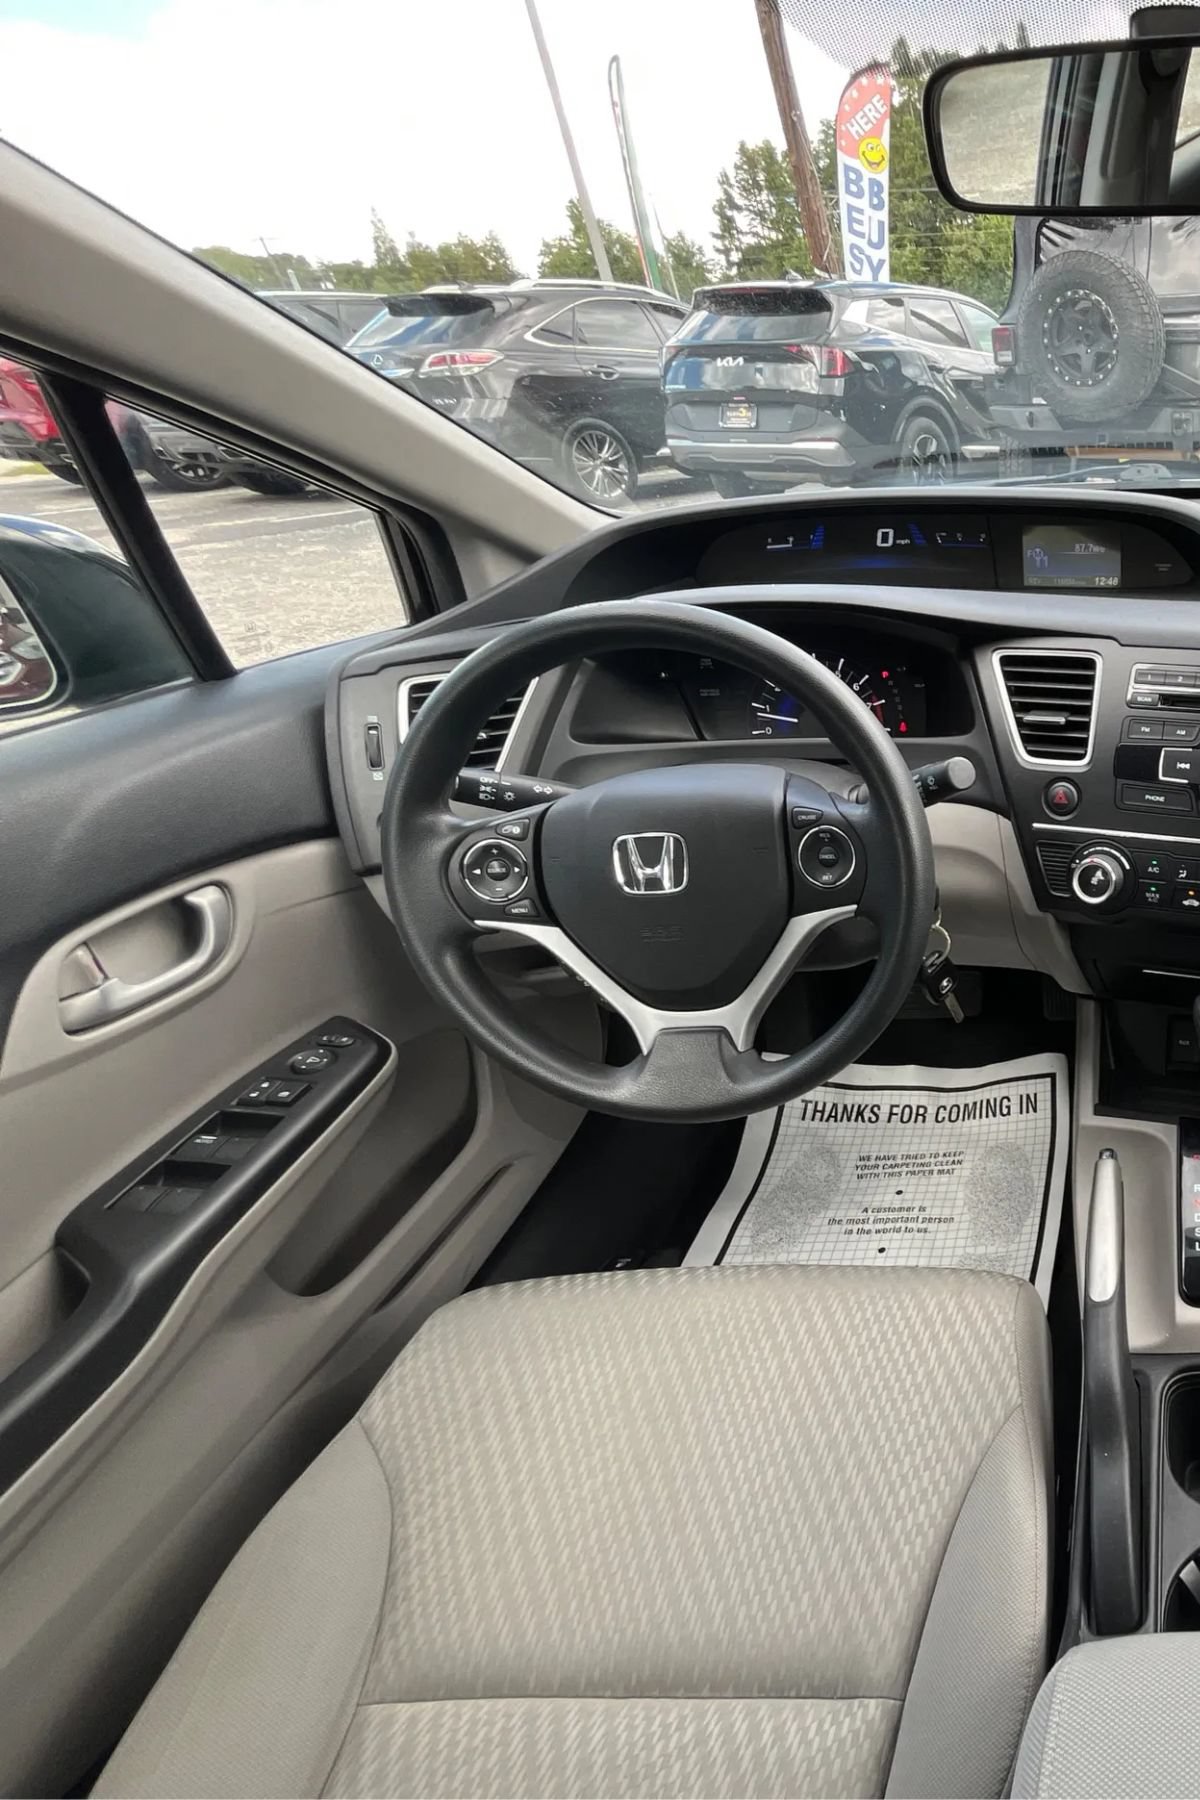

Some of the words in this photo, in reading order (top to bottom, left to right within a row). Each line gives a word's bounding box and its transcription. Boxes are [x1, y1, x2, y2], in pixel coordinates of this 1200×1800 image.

[847, 94, 888, 140] HERE
[866, 177, 886, 282] BUY
[876, 528, 894, 548] 0
[895, 538, 911, 546] mph
[853, 683, 860, 691] 6
[765, 727, 772, 736] 0
[1144, 794, 1165, 802] PHONE
[800, 1098, 881, 1124] THANKS
[887, 1103, 928, 1124] FOR
[934, 1095, 1011, 1123] COMING
[1019, 1092, 1038, 1115] IN
[858, 1154, 873, 1162] WE
[875, 1153, 898, 1162] HAVE
[900, 1152, 926, 1161] TRIED
[929, 1152, 940, 1160] TO
[942, 1150, 965, 1158] KEEP
[855, 1163, 880, 1172] YOUR
[882, 1160, 932, 1171] CARPETING
[934, 1159, 963, 1167] CLEAN
[856, 1172, 881, 1180] WITH
[883, 1170, 903, 1179] THIS
[905, 1169, 935, 1177] PAPER
[937, 1168, 956, 1176] MAT
[861, 1206, 869, 1214] A
[871, 1205, 916, 1214] customer
[918, 1205, 927, 1213] is
[827, 1217, 843, 1226] the
[845, 1216, 870, 1225] most
[872, 1215, 919, 1226] important
[921, 1216, 955, 1225] person
[843, 1227, 853, 1235] in
[856, 1226, 872, 1235] the
[875, 1225, 902, 1235] world
[904, 1225, 914, 1234] to
